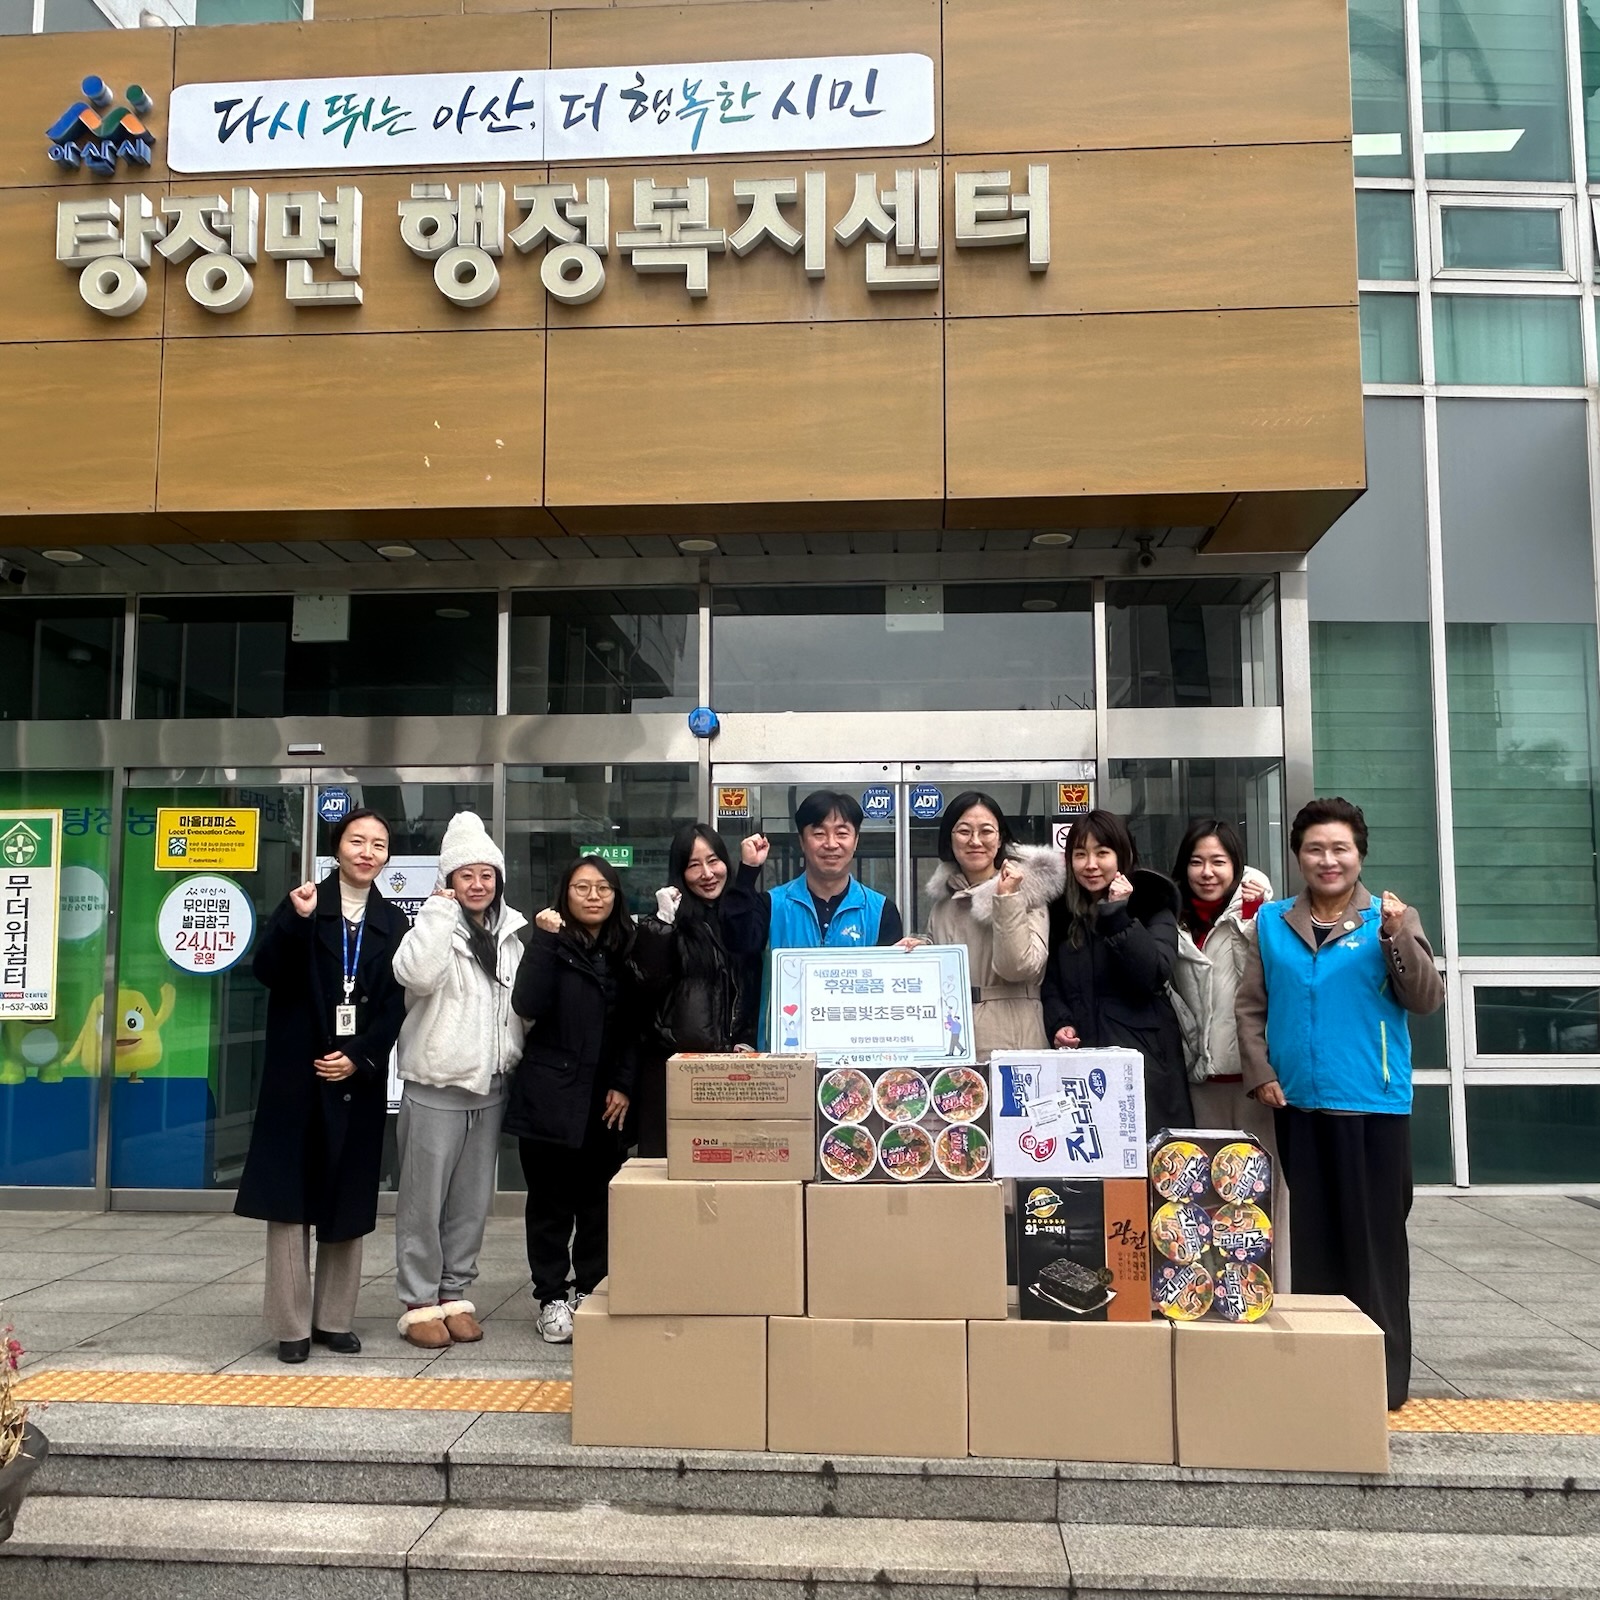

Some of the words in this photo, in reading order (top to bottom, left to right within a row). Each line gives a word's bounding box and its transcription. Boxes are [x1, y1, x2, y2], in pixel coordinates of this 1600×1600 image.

[214, 95, 308, 144] 다시
[322, 93, 416, 148] 뛰는
[432, 77, 537, 134] 아산,
[560, 83, 603, 131] 더
[620, 72, 761, 151] 행복한
[772, 68, 886, 120] 시민
[48, 139, 152, 175] 아산시
[57, 186, 363, 317] 탕정면
[398, 164, 1050, 307] 행정복지센터
[322, 798, 346, 811] ADT
[866, 796, 890, 809] ADT
[914, 795, 939, 808] ADT
[179, 816, 236, 828] 마을대피소
[602, 848, 629, 858] AED
[200, 888, 226, 896] 아산시
[183, 899, 230, 913] 무인민원
[4, 875, 32, 989] 무더위쉼터
[182, 915, 230, 929] 발급창구
[175, 931, 236, 951] 24시간
[194, 952, 215, 965] 운영
[824, 978, 884, 994] 후원물품
[892, 977, 923, 993] 전달
[810, 1005, 937, 1022] 한들물빛초등학교
[1171, 1155, 1205, 1199] 진라면
[1233, 1155, 1264, 1200] 진라면
[1109, 1219, 1147, 1250] 광천
[1175, 1205, 1200, 1254] 진라면
[1219, 1229, 1264, 1249] 진라면
[1159, 1266, 1196, 1305] 진라면
[1224, 1269, 1248, 1316] 진라면
